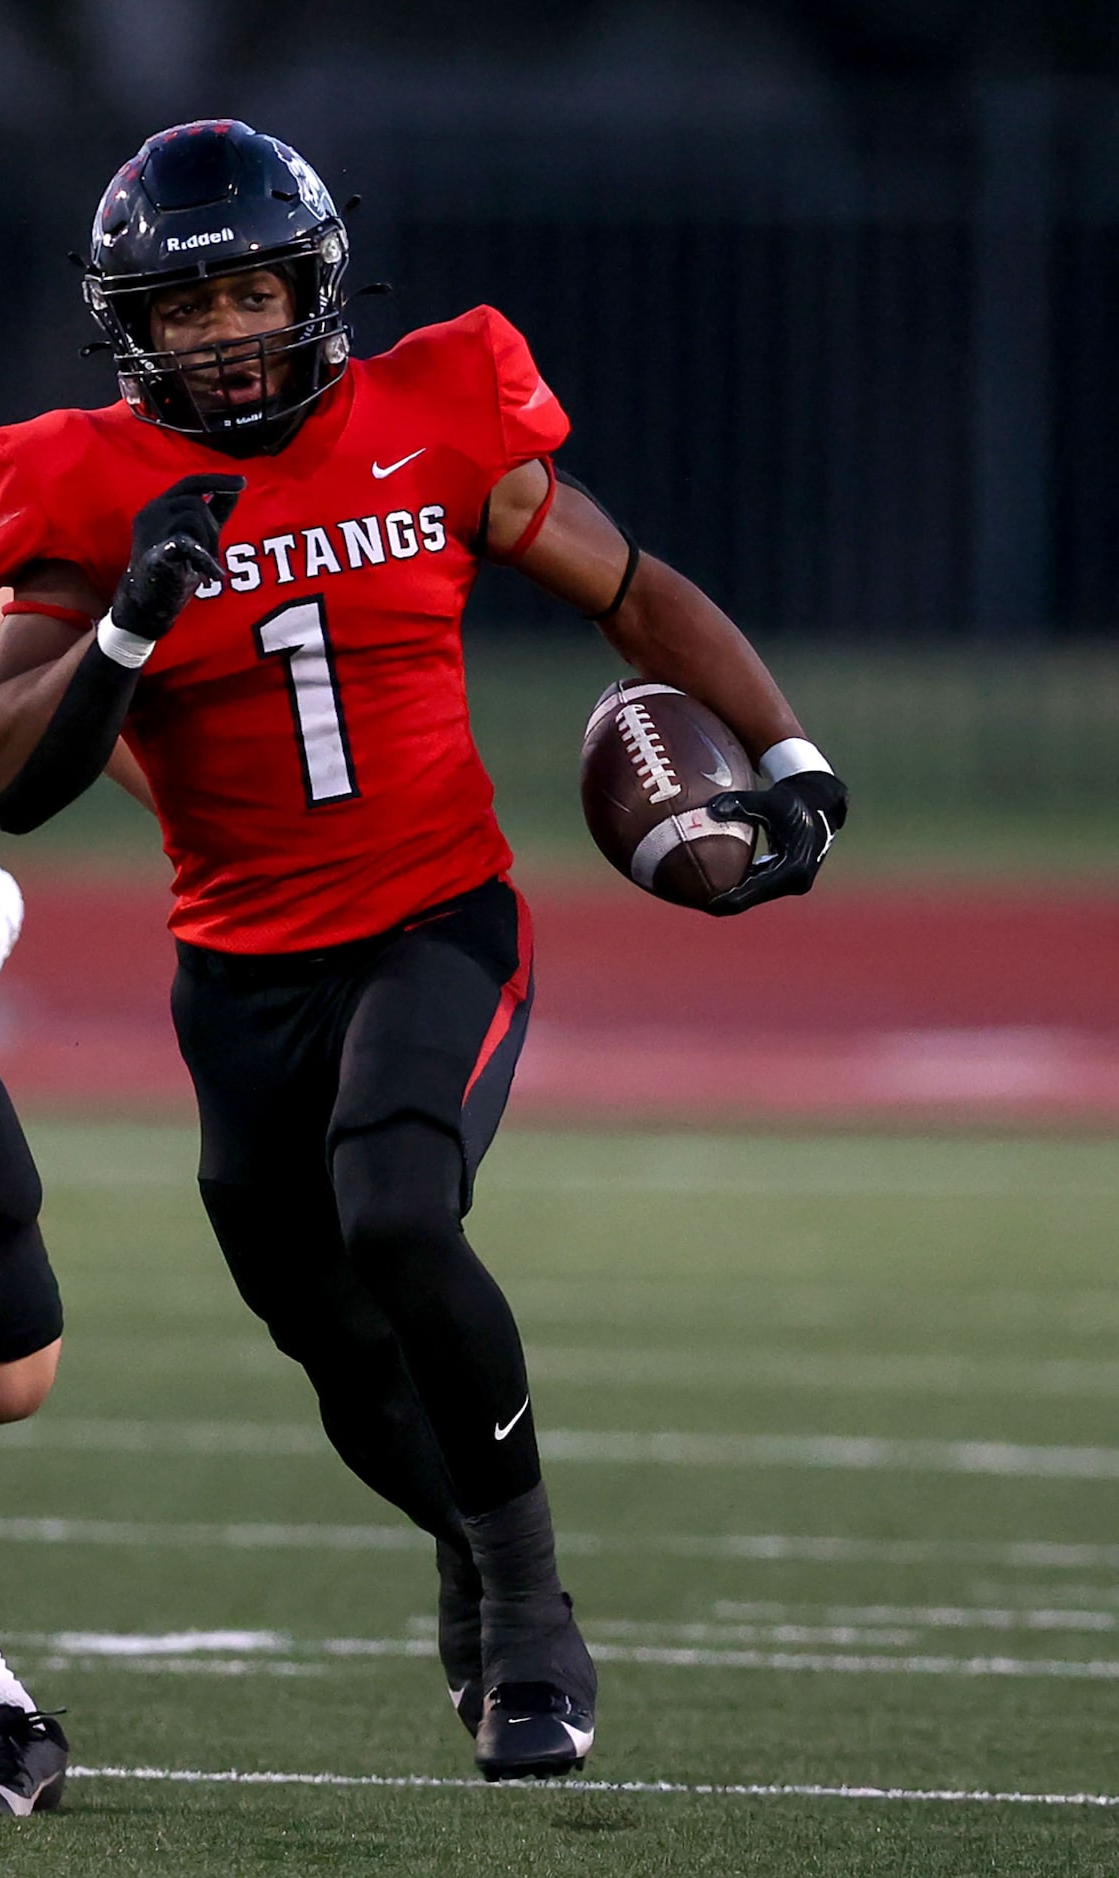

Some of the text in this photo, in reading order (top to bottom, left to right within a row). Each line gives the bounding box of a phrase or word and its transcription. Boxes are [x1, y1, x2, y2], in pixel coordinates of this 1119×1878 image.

[166, 227, 235, 252] Riddell
[193, 504, 448, 600] STANGS
[251, 593, 362, 810] 1
